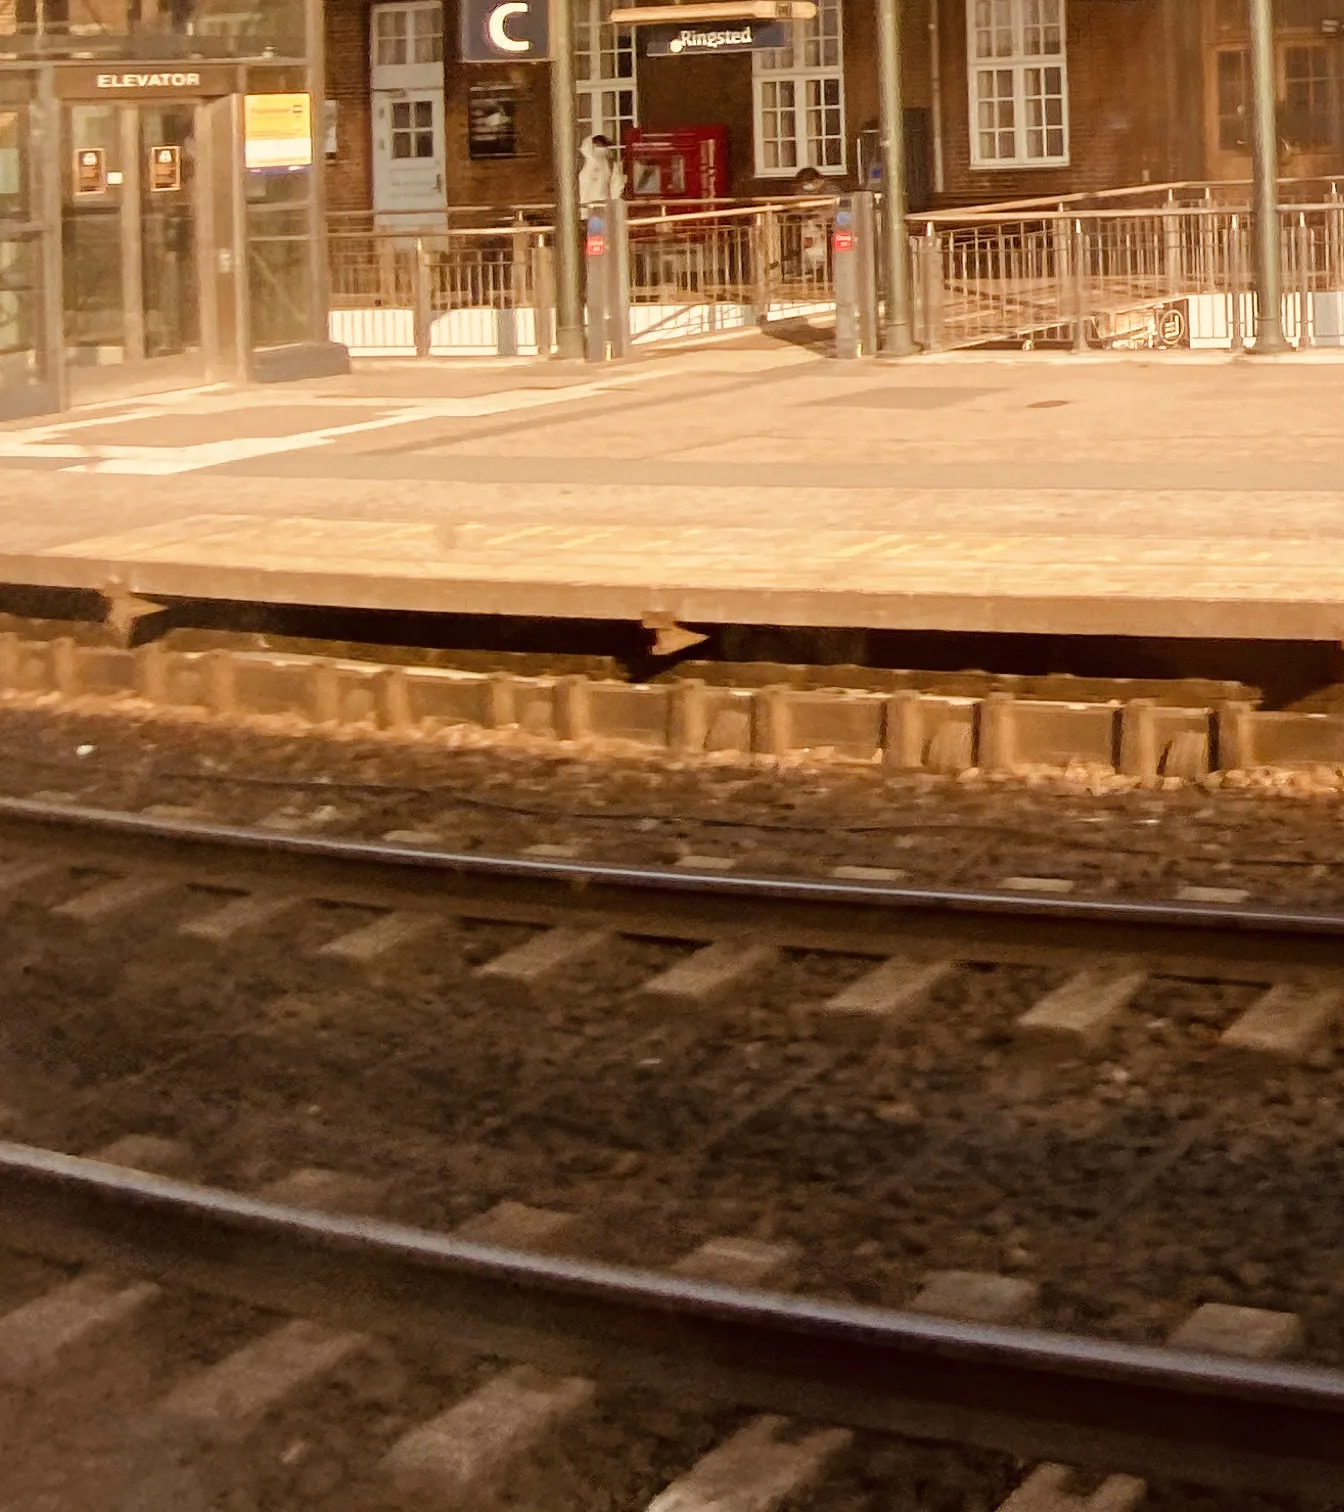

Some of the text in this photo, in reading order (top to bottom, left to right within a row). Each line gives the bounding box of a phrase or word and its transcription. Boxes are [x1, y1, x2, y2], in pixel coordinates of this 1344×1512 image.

[488, 1, 531, 52] C
[680, 26, 753, 48] Ringsted
[96, 72, 200, 88] ELEVATOR
